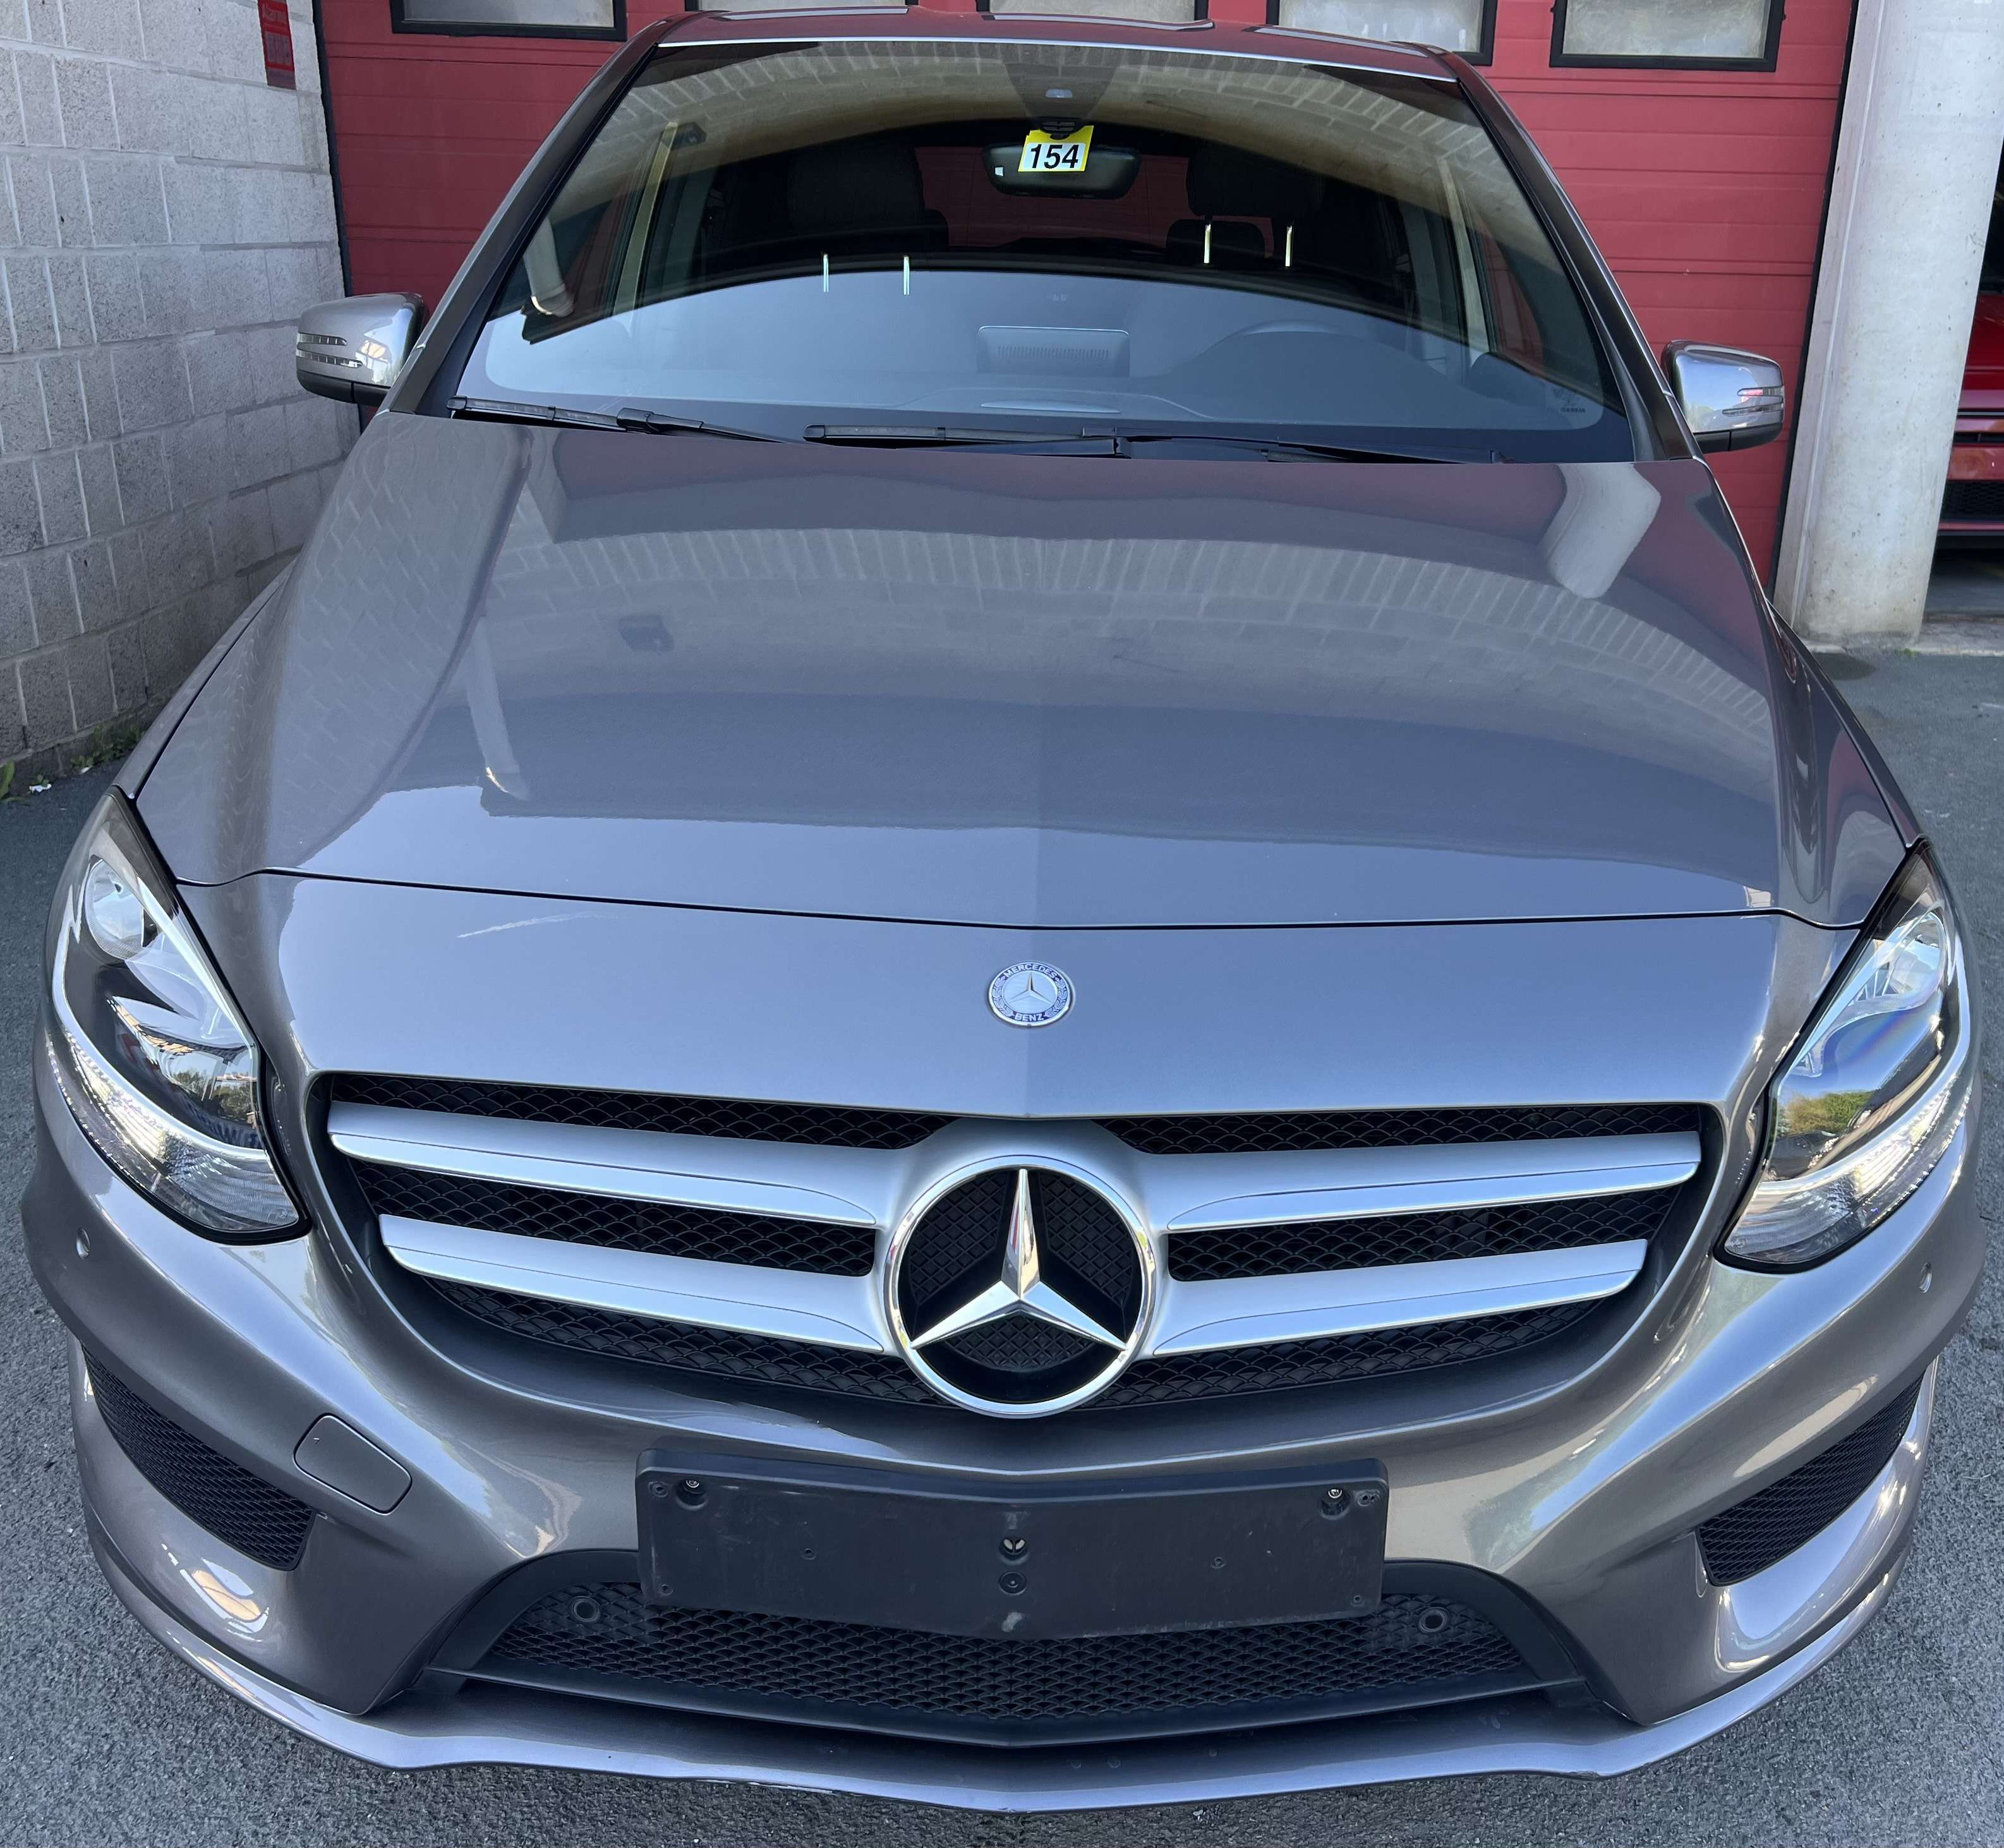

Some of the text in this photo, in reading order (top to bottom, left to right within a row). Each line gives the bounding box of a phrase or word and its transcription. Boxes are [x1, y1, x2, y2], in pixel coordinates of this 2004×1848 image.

[1030, 144, 1080, 169] 154
[1004, 963, 1058, 978] MERCEDES
[1014, 1013, 1044, 1022] BENZ
